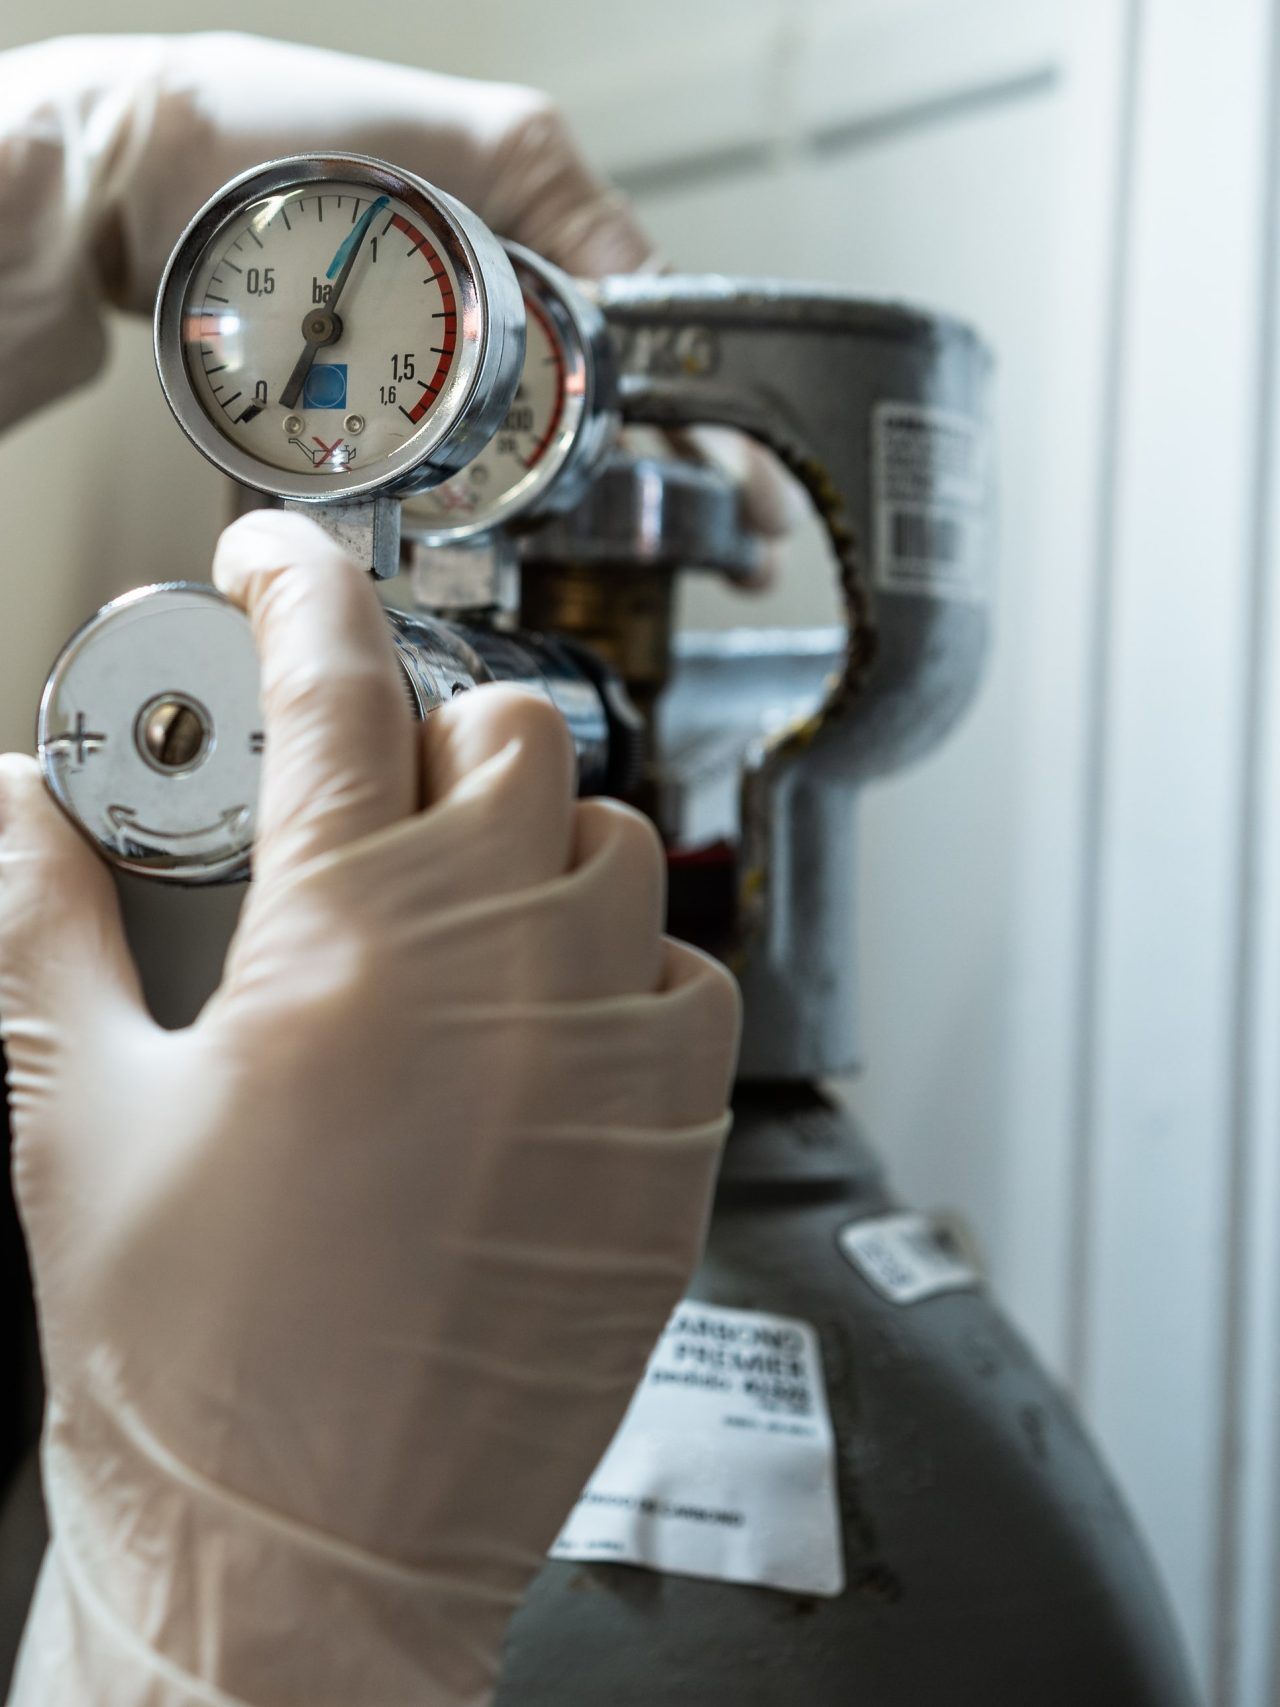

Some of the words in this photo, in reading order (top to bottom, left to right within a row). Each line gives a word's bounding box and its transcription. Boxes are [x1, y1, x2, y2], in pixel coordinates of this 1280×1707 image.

[370, 236, 378, 264] 1
[246, 268, 275, 297] 0,5
[312, 277, 334, 304] ba
[391, 354, 415, 383] 1,5
[379, 386, 396, 406] 1,6
